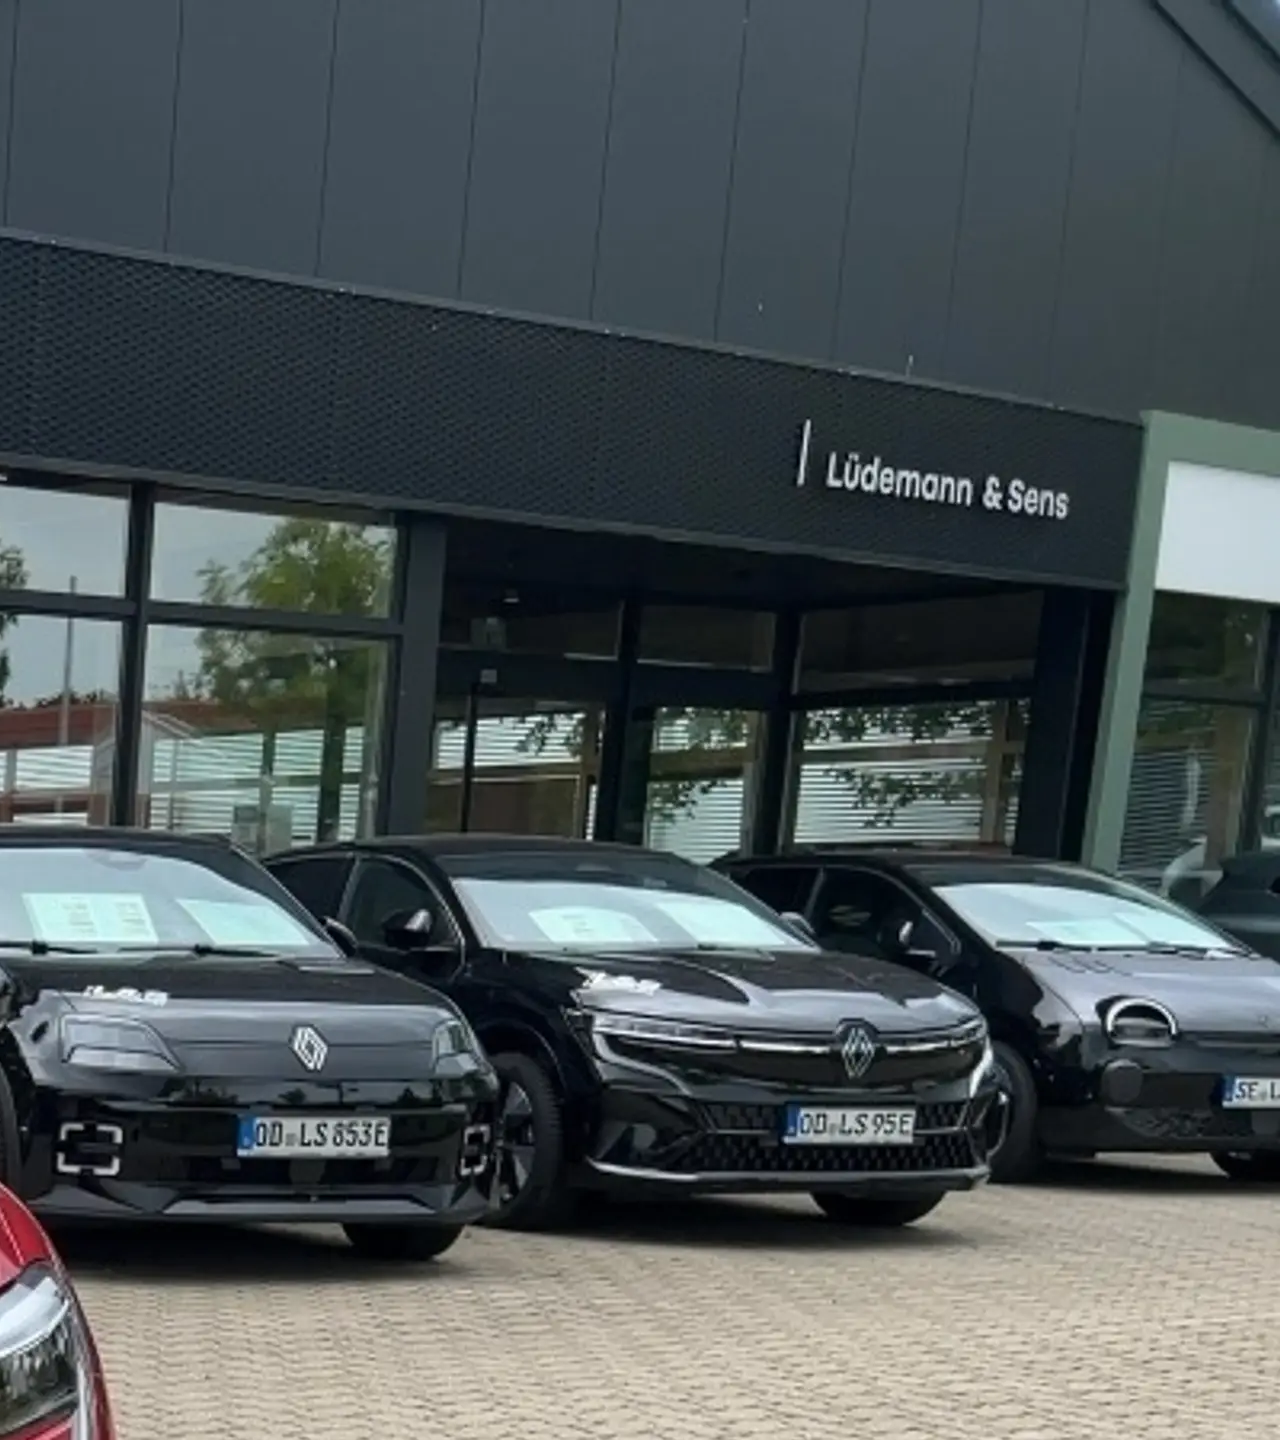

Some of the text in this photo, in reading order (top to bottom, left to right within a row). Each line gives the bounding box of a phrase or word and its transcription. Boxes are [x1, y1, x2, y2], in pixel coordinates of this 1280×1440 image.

[826, 451, 1070, 520] Lüdemann & Sens
[256, 1121, 284, 1147] OD
[299, 1121, 328, 1147] LS
[800, 1112, 914, 1136] OD LS 95E
